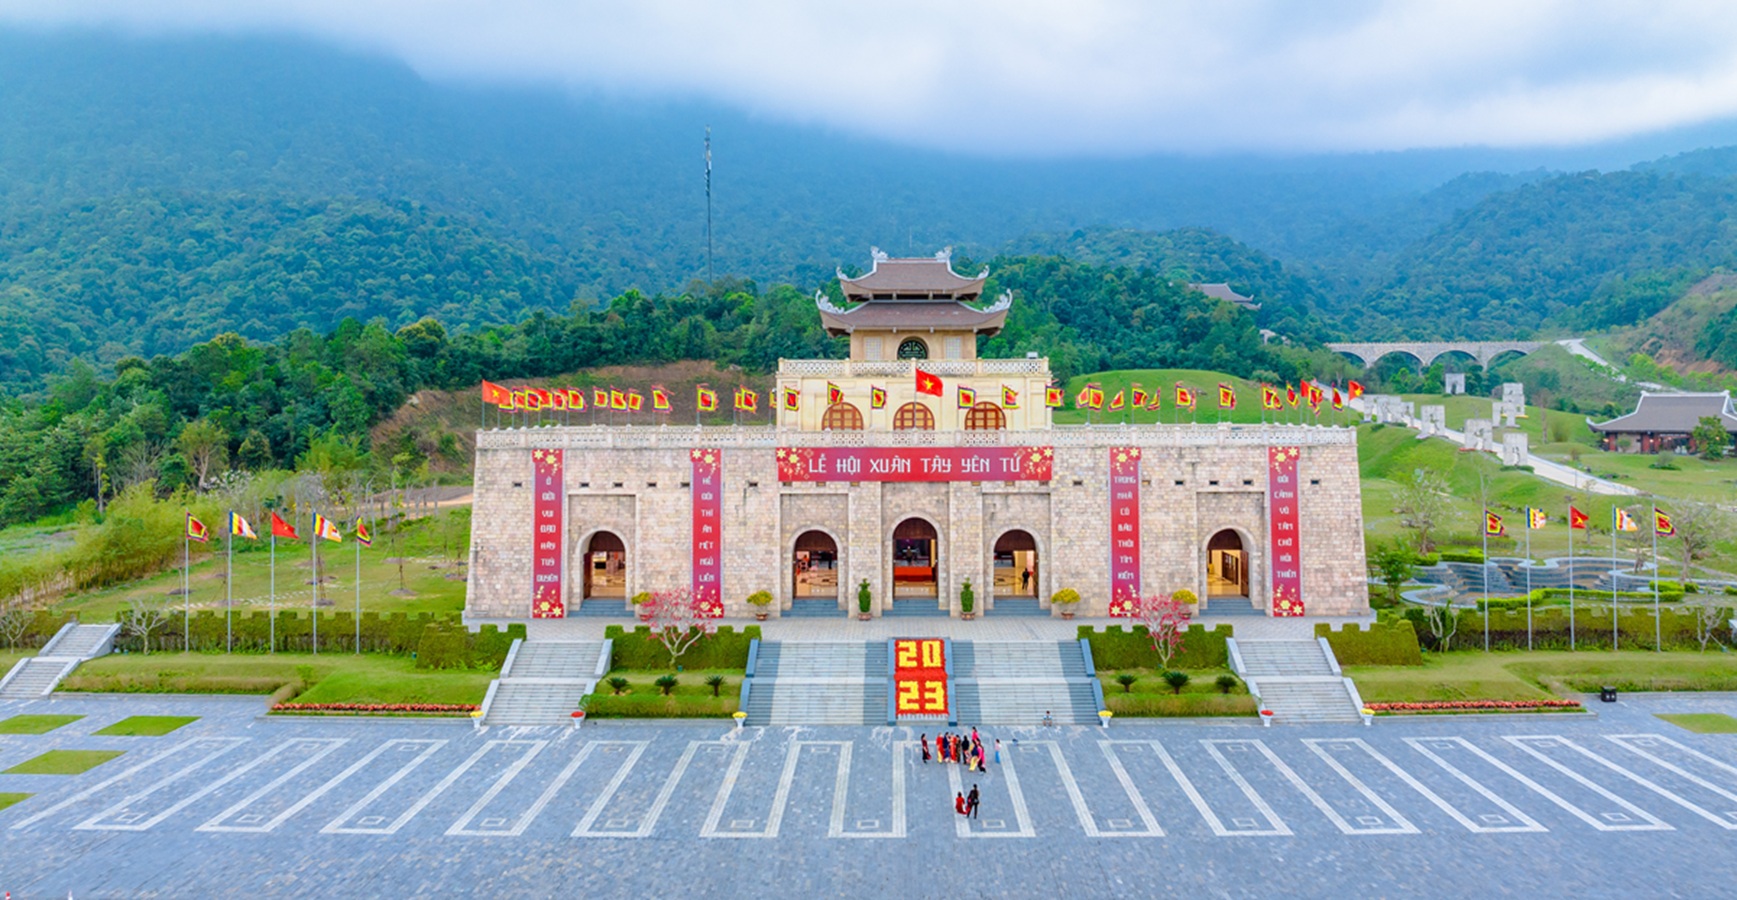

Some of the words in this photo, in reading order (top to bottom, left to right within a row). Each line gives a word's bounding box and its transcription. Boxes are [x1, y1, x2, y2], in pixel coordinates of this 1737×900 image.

[809, 453, 826, 473] LỄ
[836, 455, 860, 475] HỘI
[870, 454, 910, 472] XUÂN
[921, 454, 951, 473] TÂY
[962, 454, 989, 473] YÊN
[1000, 451, 1021, 473] TỨ
[1114, 475, 1136, 484] TRONG
[541, 509, 554, 518] VUI
[898, 640, 942, 667] 20
[899, 681, 945, 710] 23
